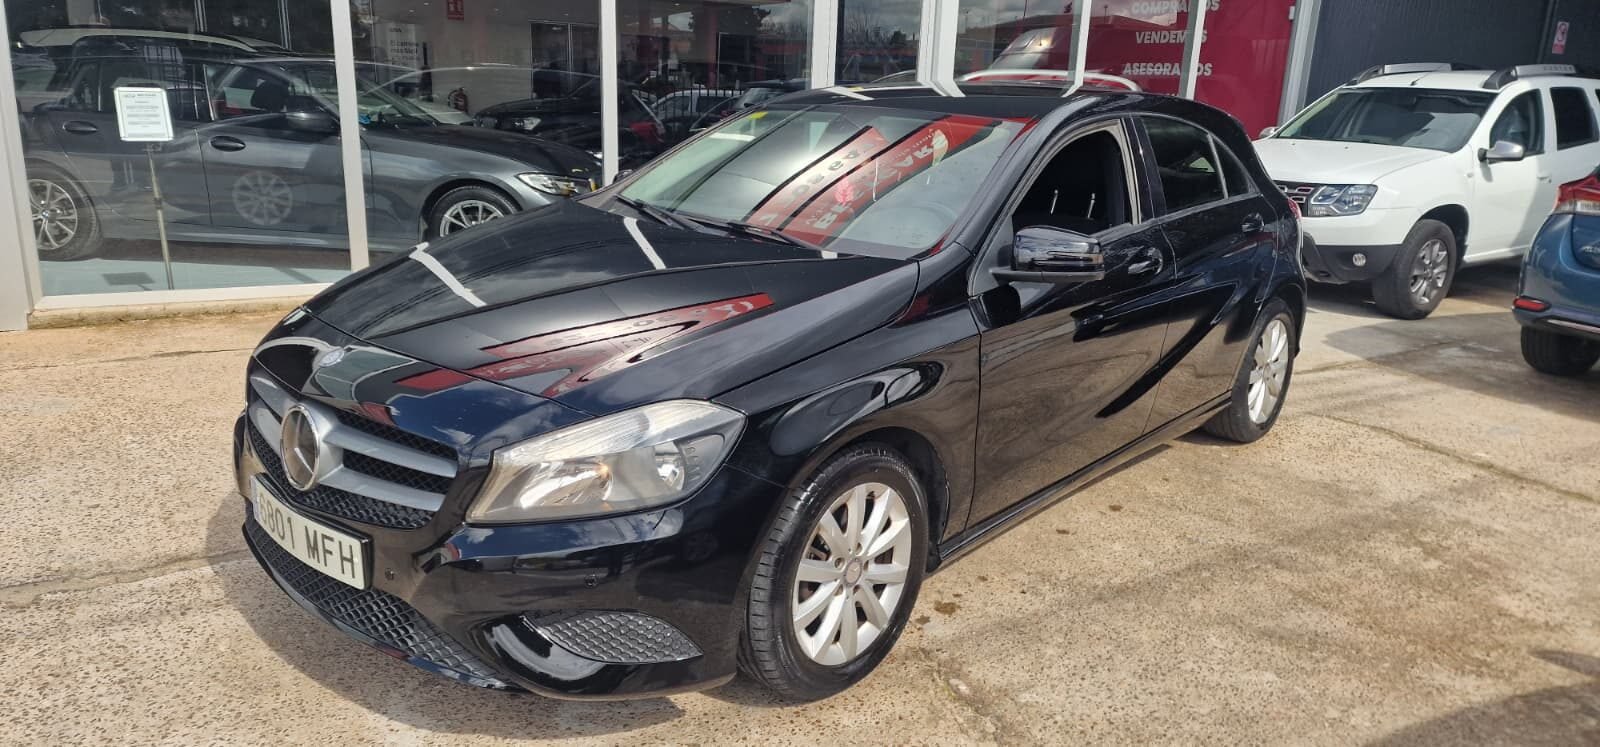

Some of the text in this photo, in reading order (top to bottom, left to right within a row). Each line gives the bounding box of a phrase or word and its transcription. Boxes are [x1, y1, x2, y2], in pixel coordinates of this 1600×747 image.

[1135, 30, 1208, 44] VENDEMS
[1122, 62, 1213, 76] ASESORAOS
[259, 492, 356, 580] 6801 MFH
